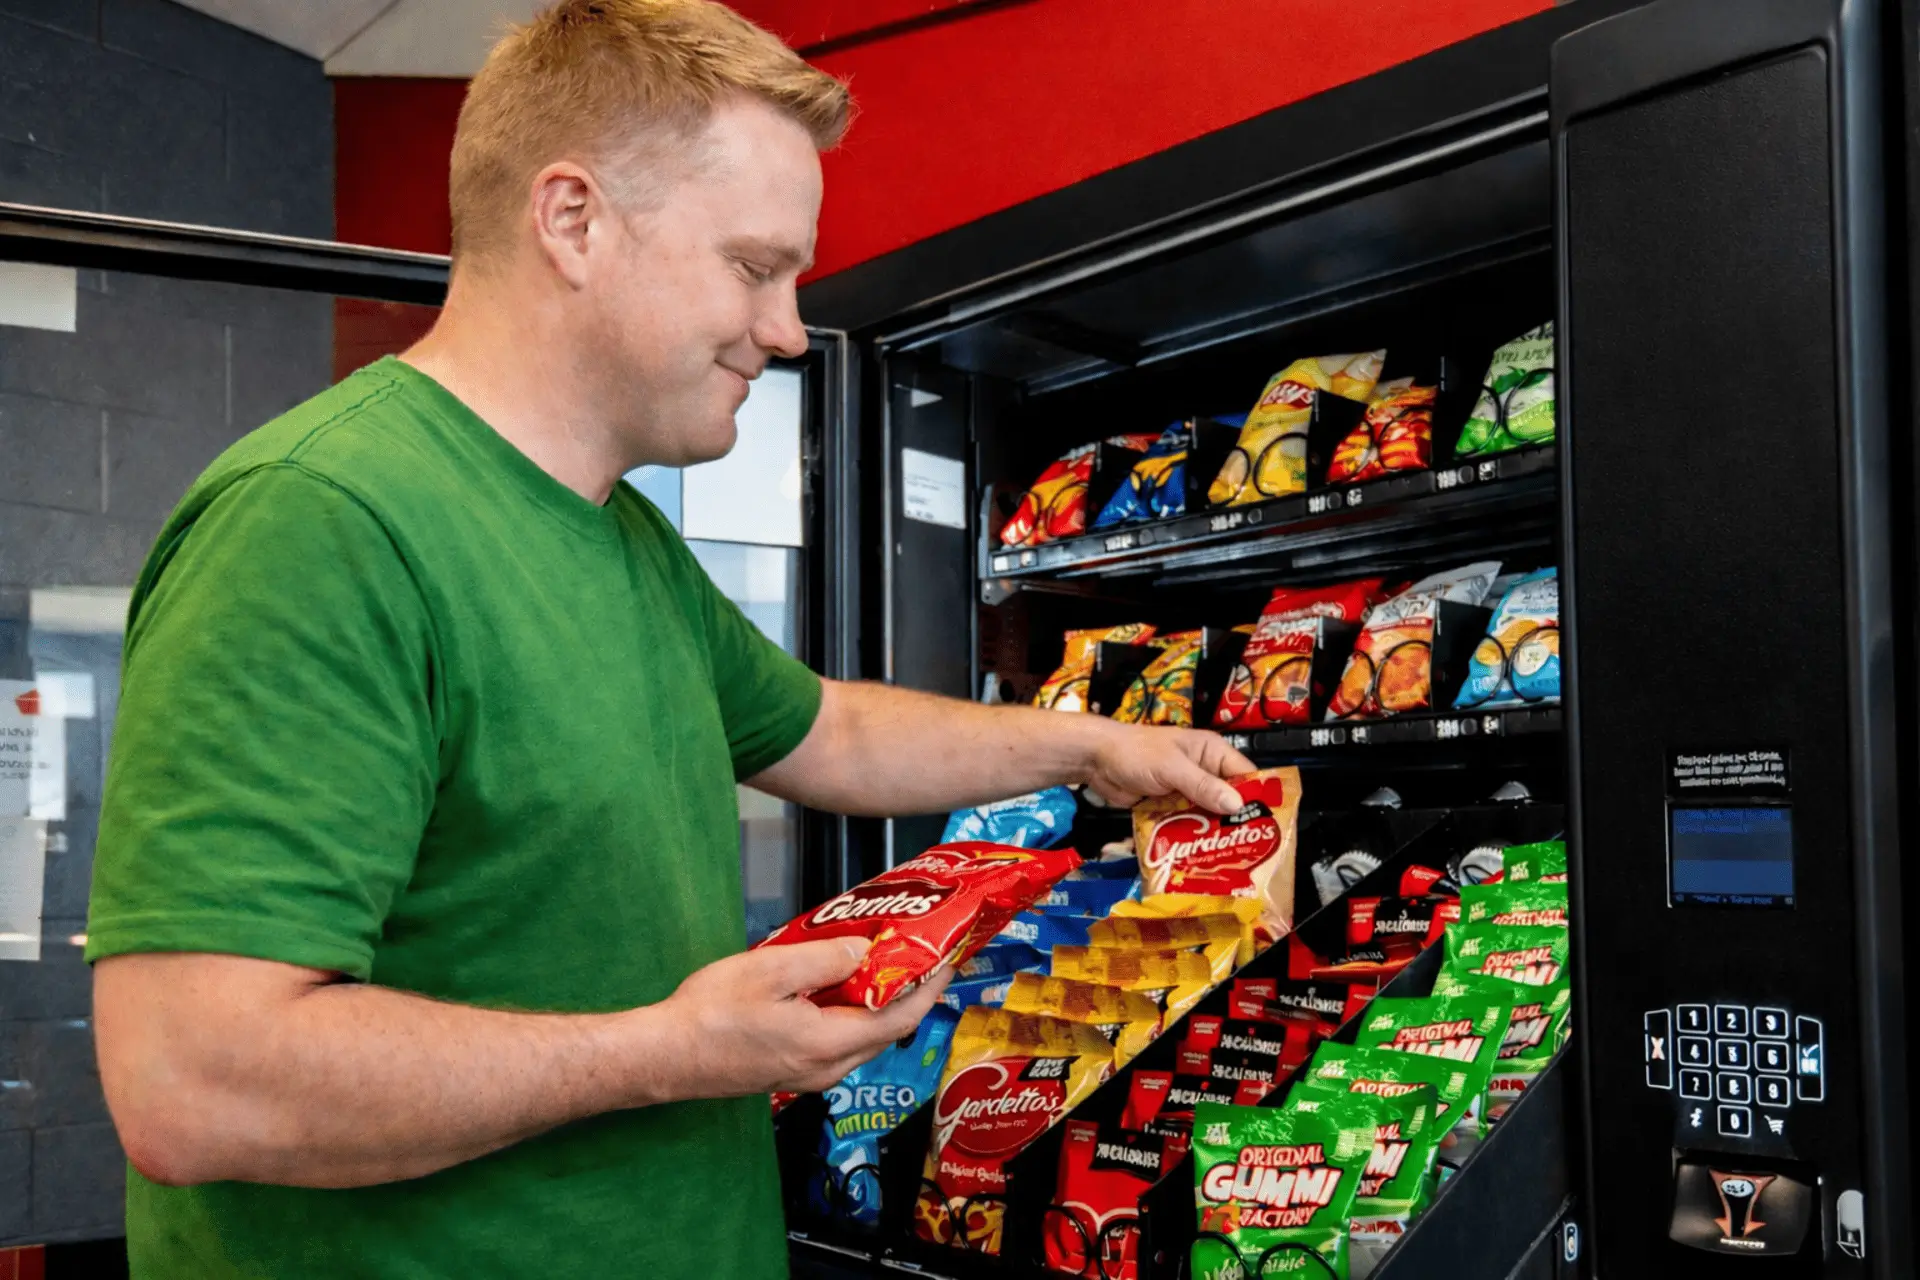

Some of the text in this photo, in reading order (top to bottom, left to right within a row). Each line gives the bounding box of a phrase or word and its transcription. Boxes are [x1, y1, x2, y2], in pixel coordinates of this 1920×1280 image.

[1689, 1010, 1777, 1031] 1 2 3
[1690, 1044, 1700, 1060] 4
[1767, 1049, 1778, 1066] 6
[827, 1084, 916, 1114] OREO
[1768, 1083, 1779, 1099] 9
[1730, 1113, 1740, 1130] 0
[1204, 1162, 1343, 1208] GUMMI
